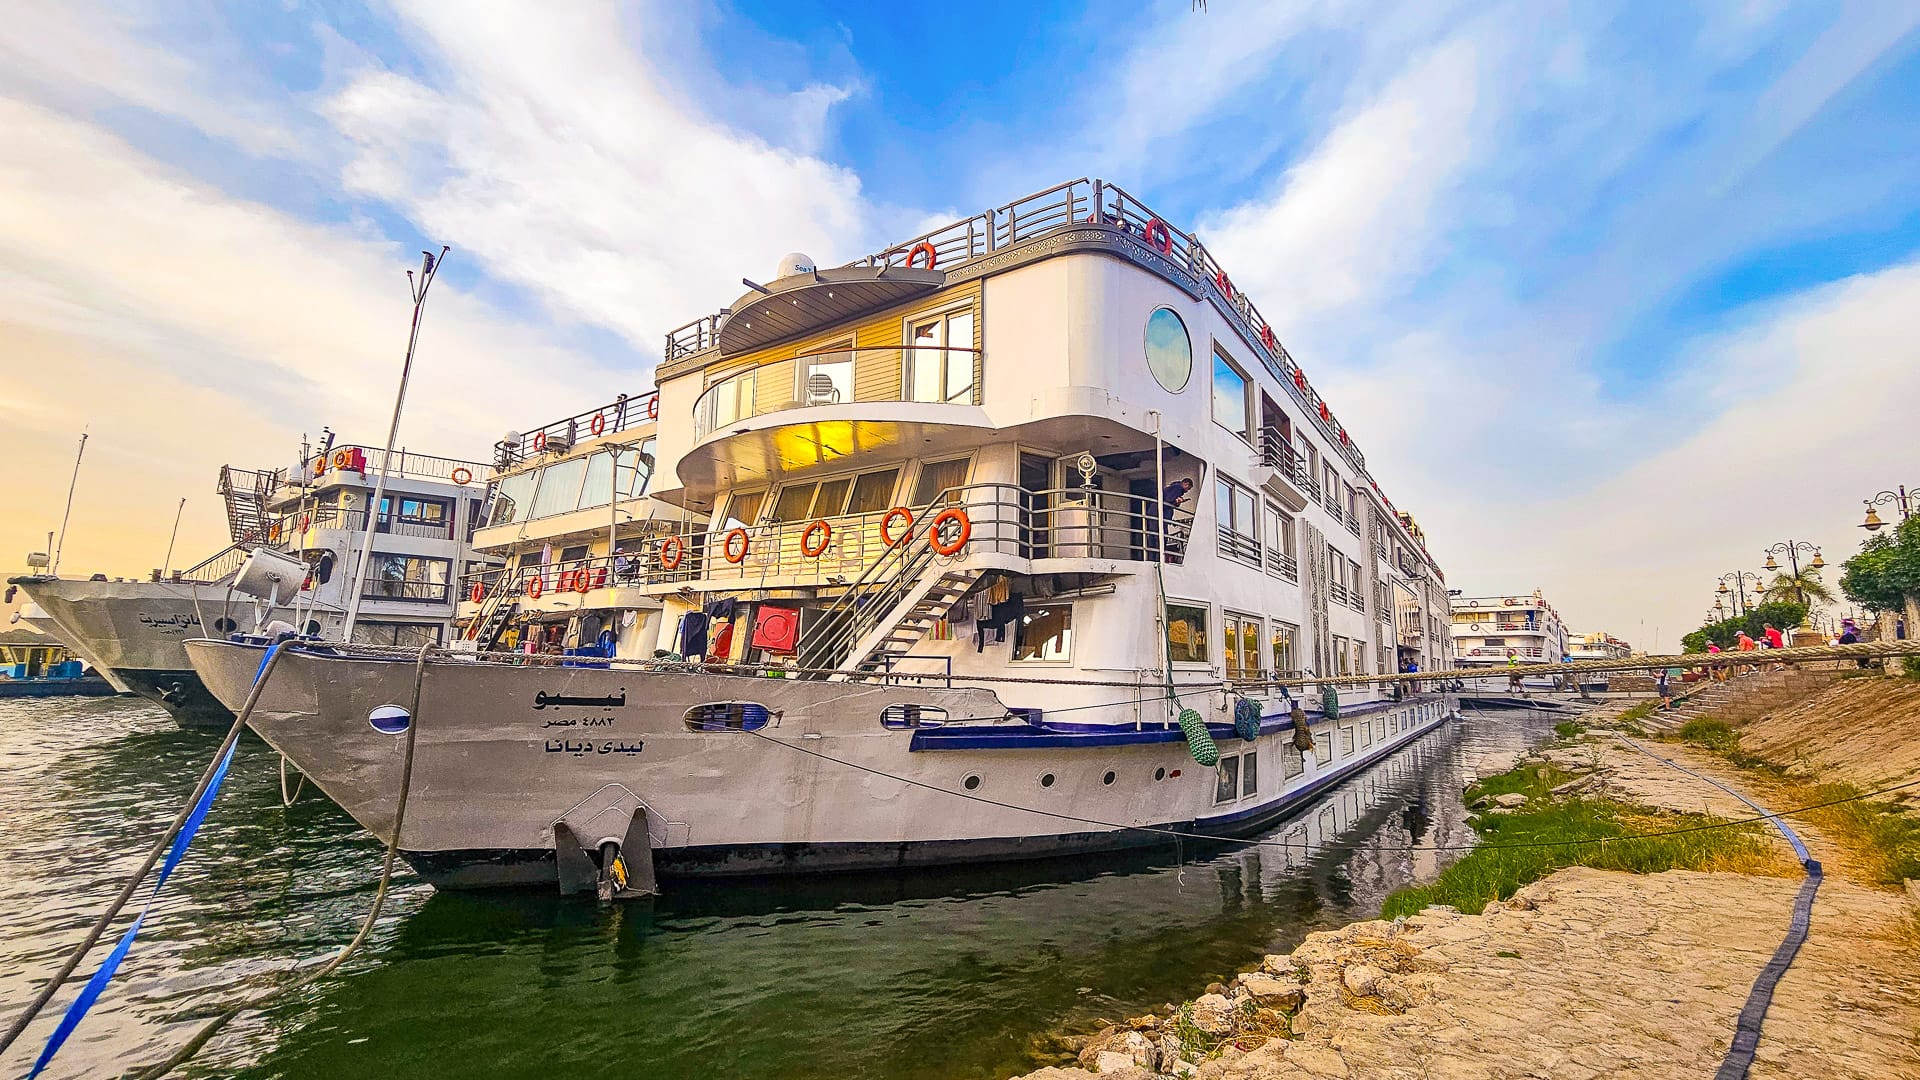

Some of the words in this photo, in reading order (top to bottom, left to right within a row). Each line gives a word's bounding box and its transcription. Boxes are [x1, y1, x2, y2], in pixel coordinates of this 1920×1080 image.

[532, 687, 626, 711] نيبو
[540, 717, 577, 729] مصر
[544, 739, 593, 757] ديانا
